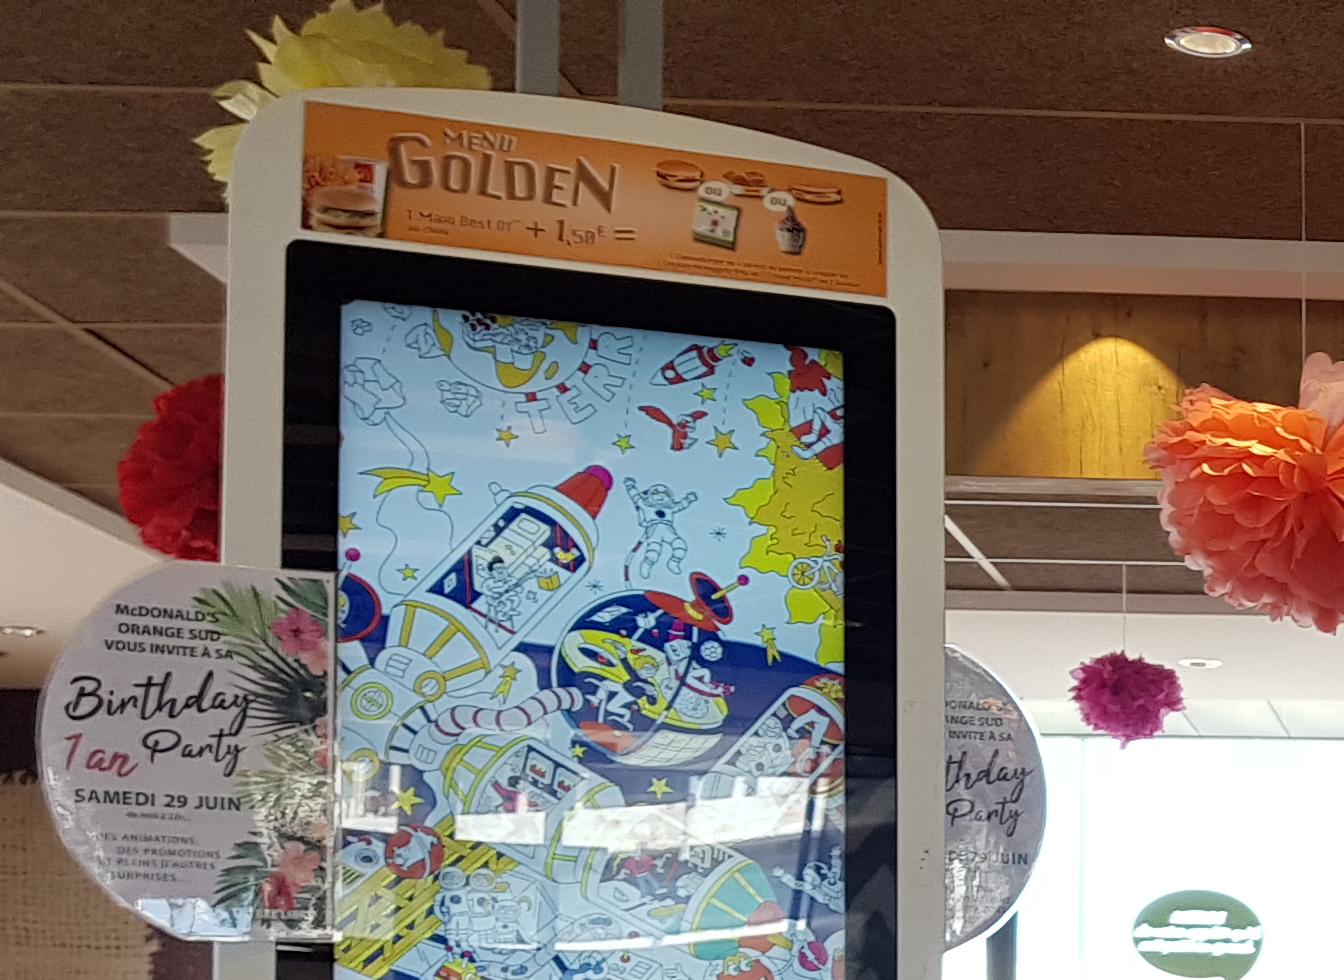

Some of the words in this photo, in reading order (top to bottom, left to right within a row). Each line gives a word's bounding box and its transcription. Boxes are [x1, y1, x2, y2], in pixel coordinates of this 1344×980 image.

[443, 128, 519, 152] MENU
[387, 131, 622, 214] GOLDEN
[115, 603, 220, 624] McDONALD'S
[118, 622, 185, 640] ORANGE
[188, 628, 221, 642] SUD
[104, 638, 146, 653] VOUS
[150, 643, 198, 658] INVITE
[214, 648, 234, 660] SA
[64, 669, 252, 736] Birthday
[86, 746, 140, 778] an
[142, 728, 247, 778] Party
[946, 749, 1036, 804] thday
[75, 788, 156, 807] SAMEDI
[163, 793, 189, 809] 29
[193, 796, 243, 811] JUIN
[946, 796, 1025, 838] Party
